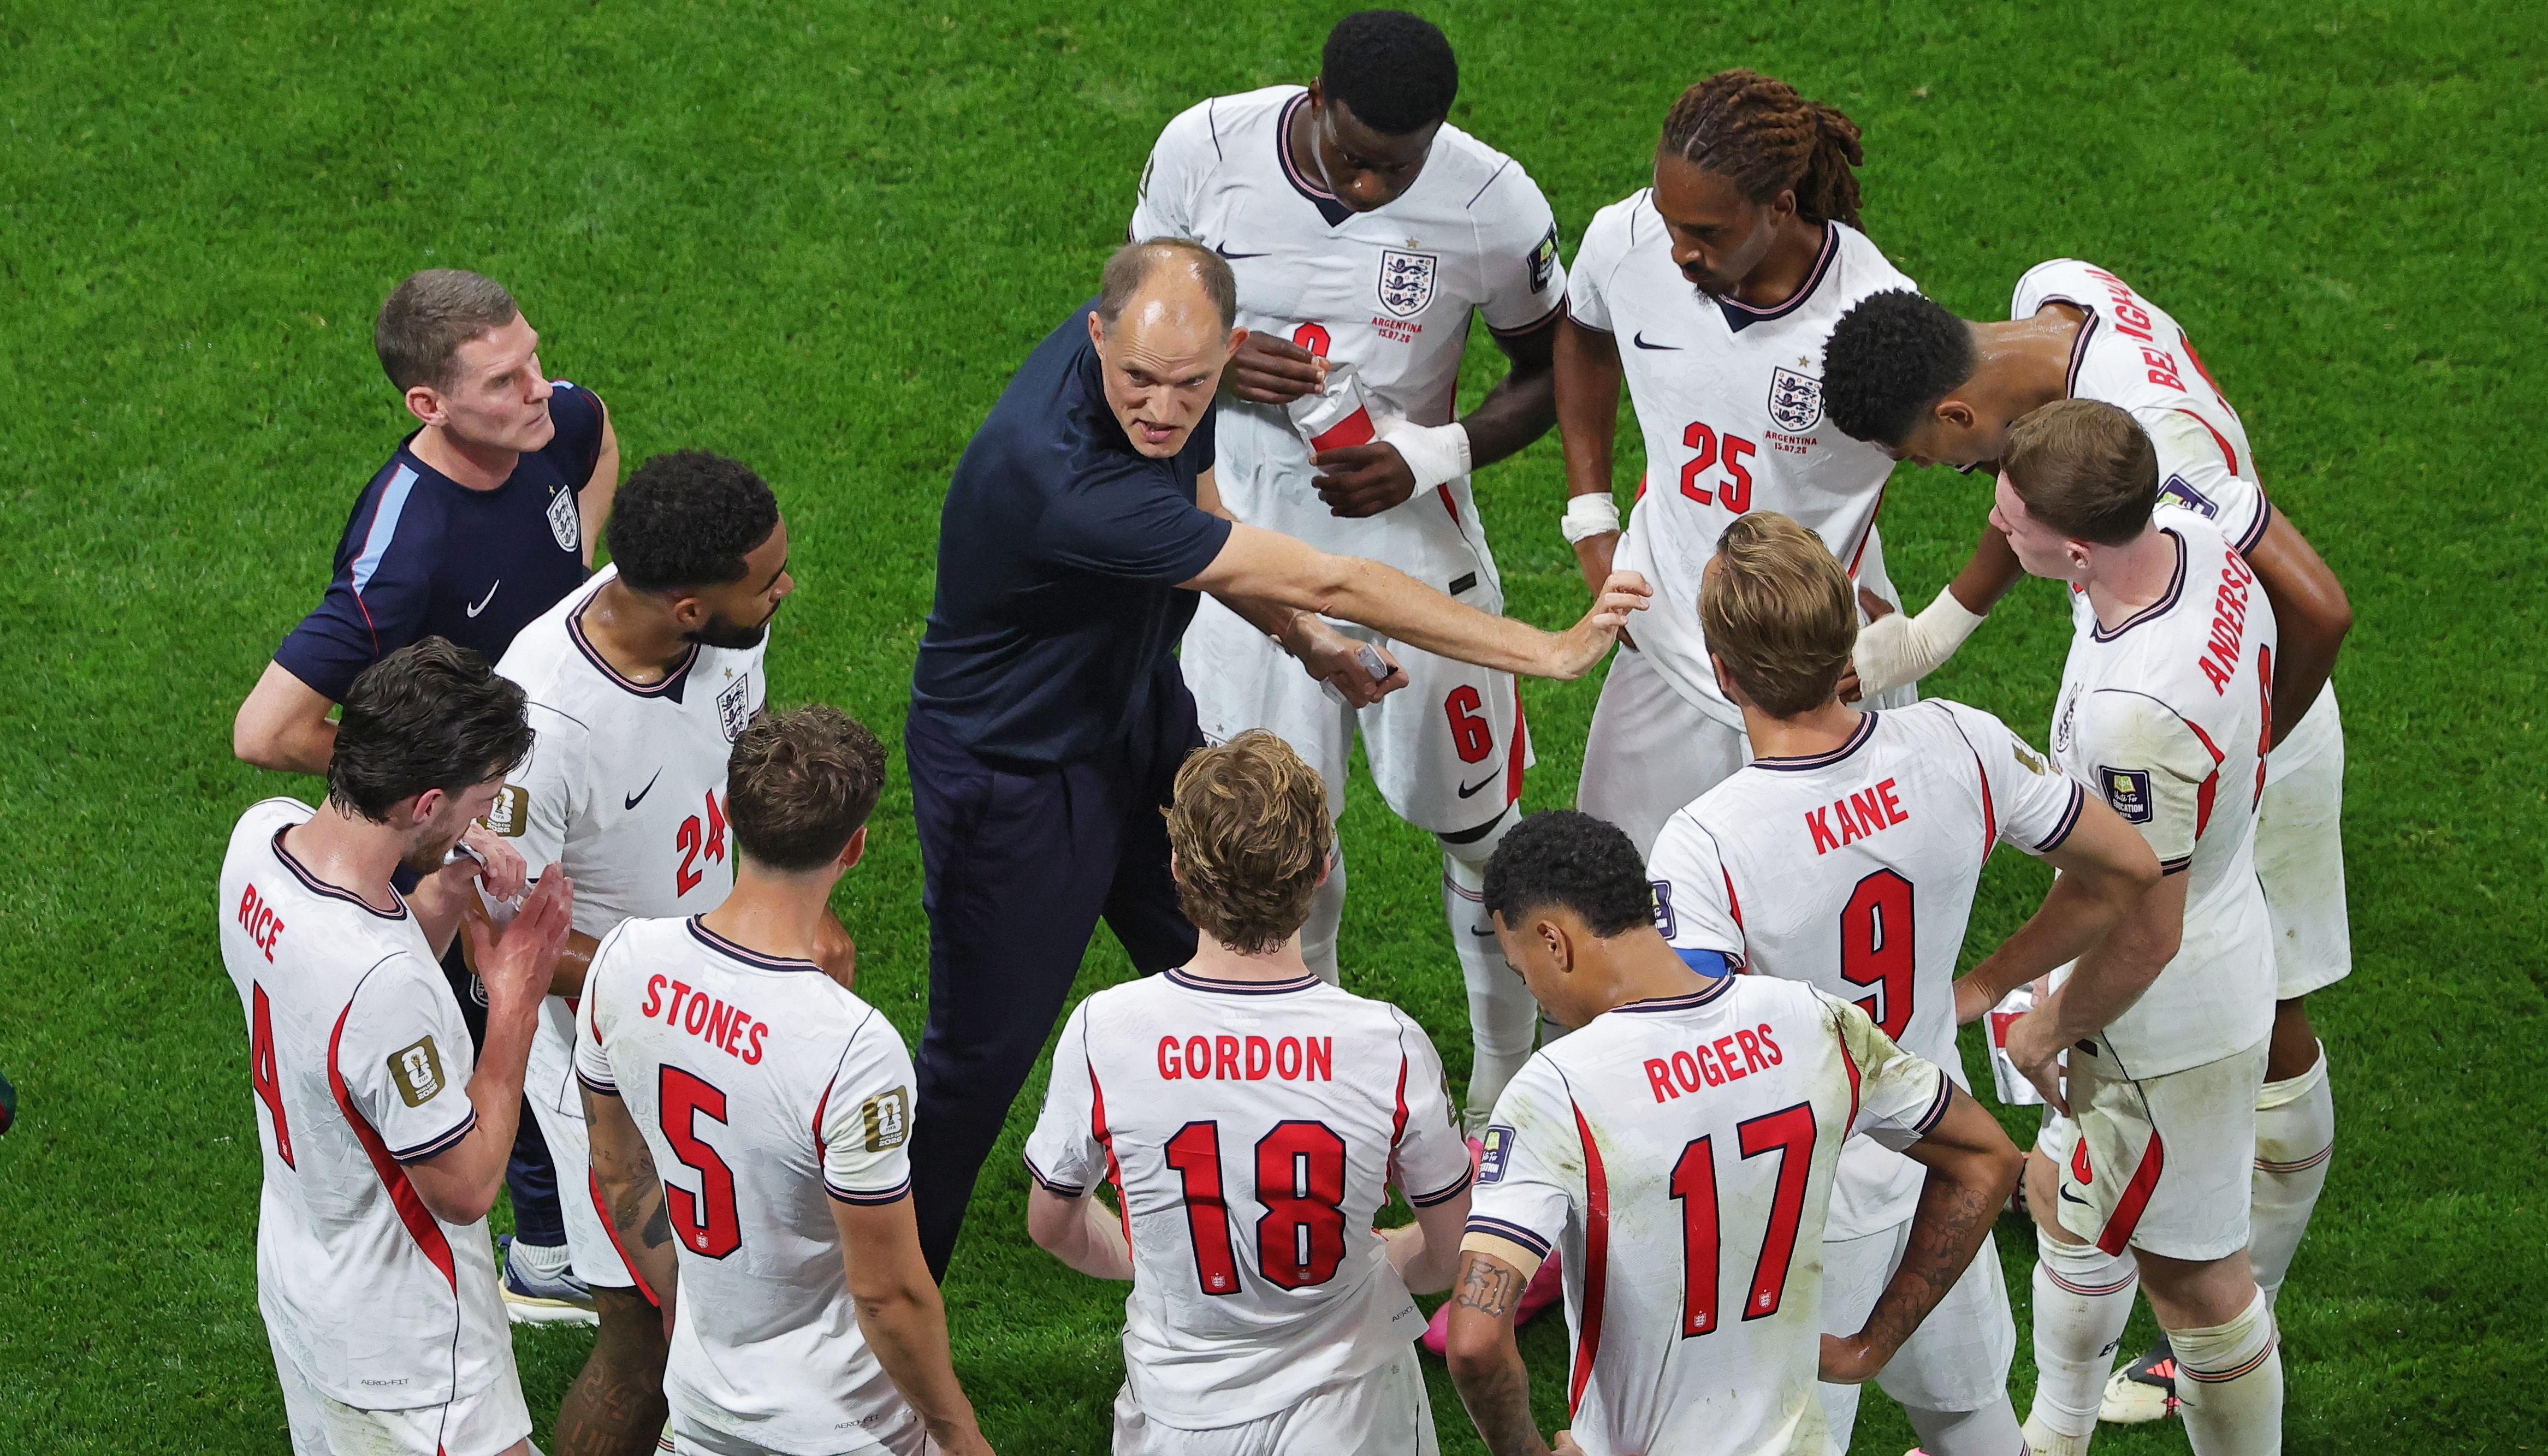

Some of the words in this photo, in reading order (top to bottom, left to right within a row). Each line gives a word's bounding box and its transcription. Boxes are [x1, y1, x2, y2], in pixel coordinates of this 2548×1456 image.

[1371, 317, 1423, 332] ARGENTINA
[1378, 328, 1411, 343] 15.07.26
[1680, 421, 1756, 514] 25
[1765, 430, 1817, 445] ARGENTINA
[1775, 442, 1807, 454] 15.07.26
[2199, 533, 2252, 697] ANDERSO
[1444, 685, 1494, 764] 6
[487, 822, 511, 833] 2026
[1805, 777, 1909, 855] KANE
[2127, 794, 2138, 803] For
[677, 787, 725, 899] 24
[239, 883, 285, 964] RICE
[1840, 867, 1915, 1043] 9
[642, 974, 768, 1065] STONES
[1158, 1036, 1332, 1081] GORDON
[252, 978, 296, 1173] 4
[415, 1083, 430, 1094] WORLD
[417, 1083, 438, 1100] 2026
[1643, 1024, 1782, 1103] ROGERS
[659, 1063, 742, 1261] 5
[879, 1136, 903, 1147] 2026
[1164, 1120, 1346, 1295] 18
[1669, 1101, 1817, 1340] 17
[361, 1378, 409, 1386] AERO-FIT
